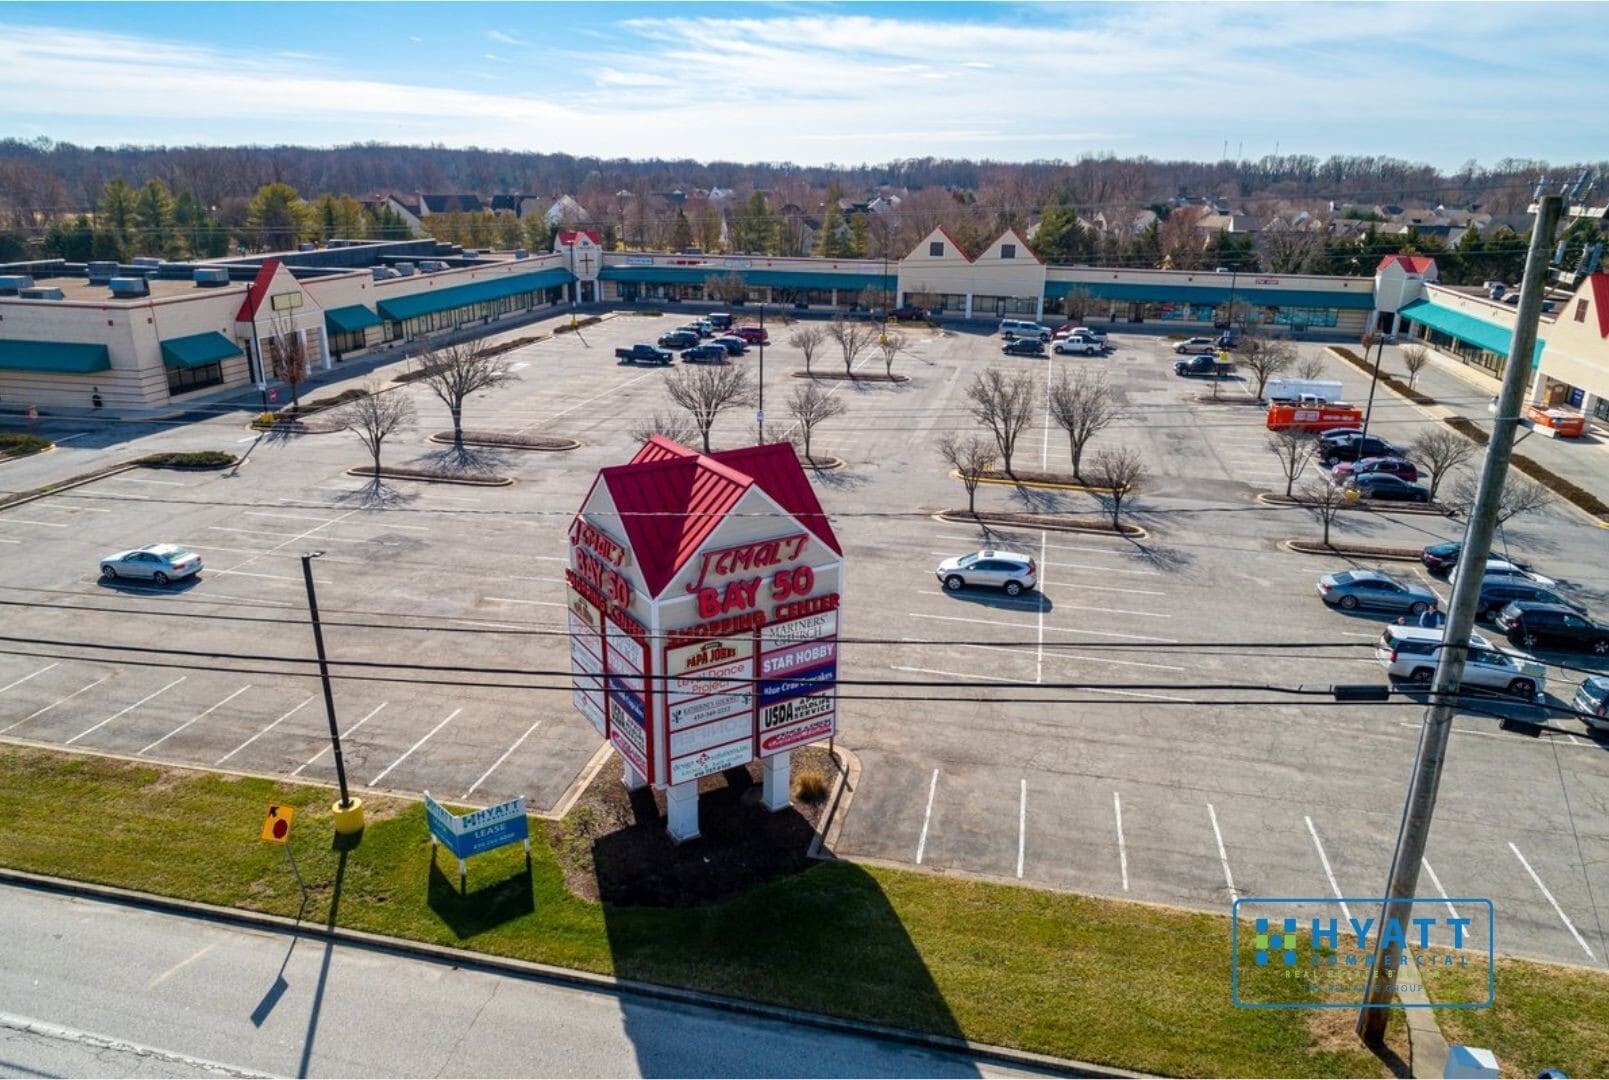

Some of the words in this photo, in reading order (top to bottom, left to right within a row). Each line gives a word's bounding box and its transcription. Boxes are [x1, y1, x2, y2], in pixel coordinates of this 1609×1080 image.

[576, 546, 604, 589] BAY
[608, 570, 630, 610] 50
[698, 576, 762, 619] BAY
[773, 565, 814, 600] 50
[666, 610, 767, 646] SHOPPING
[775, 593, 840, 620] CENTER
[687, 650, 708, 667] PAPA
[763, 655, 794, 673] STAR
[796, 644, 834, 664] HOBBY
[765, 702, 793, 727] USDA
[477, 801, 519, 820] HYATT
[475, 825, 505, 838] LEASE
